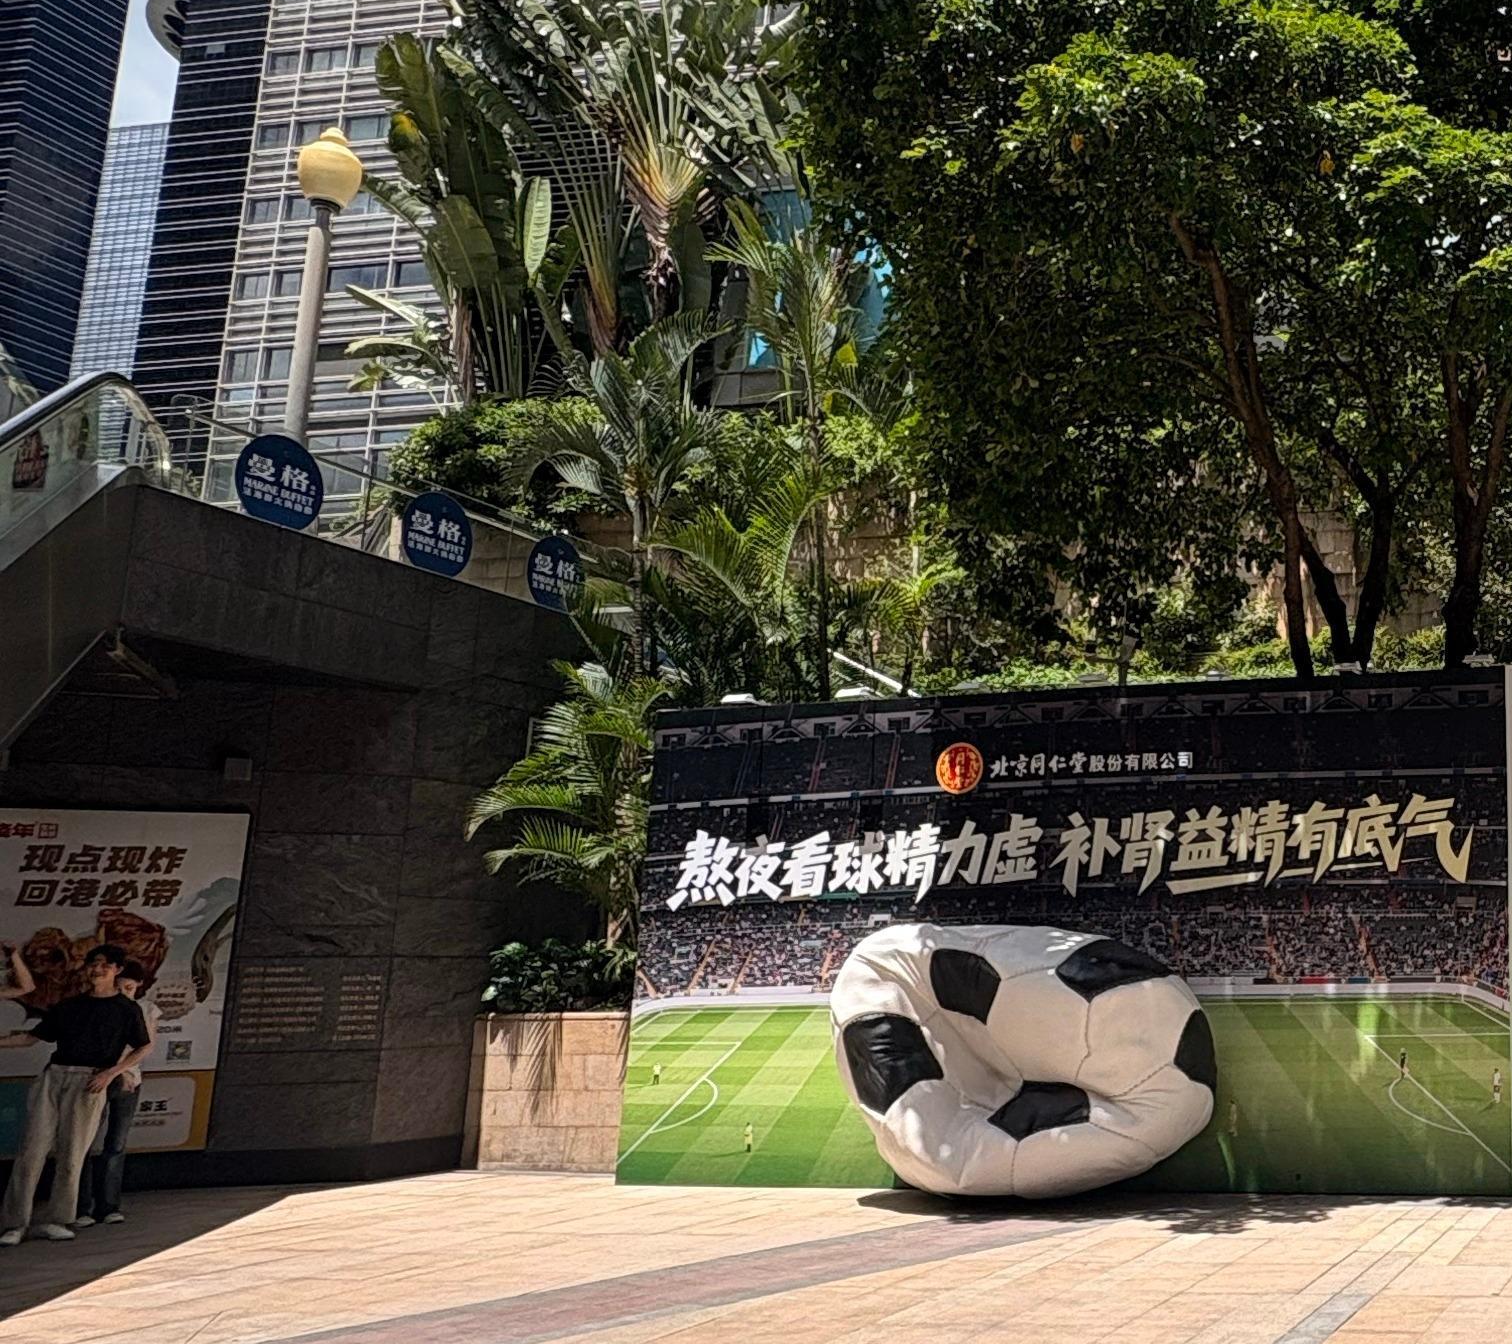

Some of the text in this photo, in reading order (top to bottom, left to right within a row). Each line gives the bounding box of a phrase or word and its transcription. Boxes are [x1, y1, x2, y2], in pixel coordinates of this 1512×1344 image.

[989, 750, 1194, 778] 北京同仁堂股份有限公司
[18, 843, 188, 875] 现点现炸
[665, 812, 1044, 912] 熬夜看球精力虚
[1048, 792, 1475, 899] 补肾益精有底气
[15, 878, 183, 907] 回港必带
